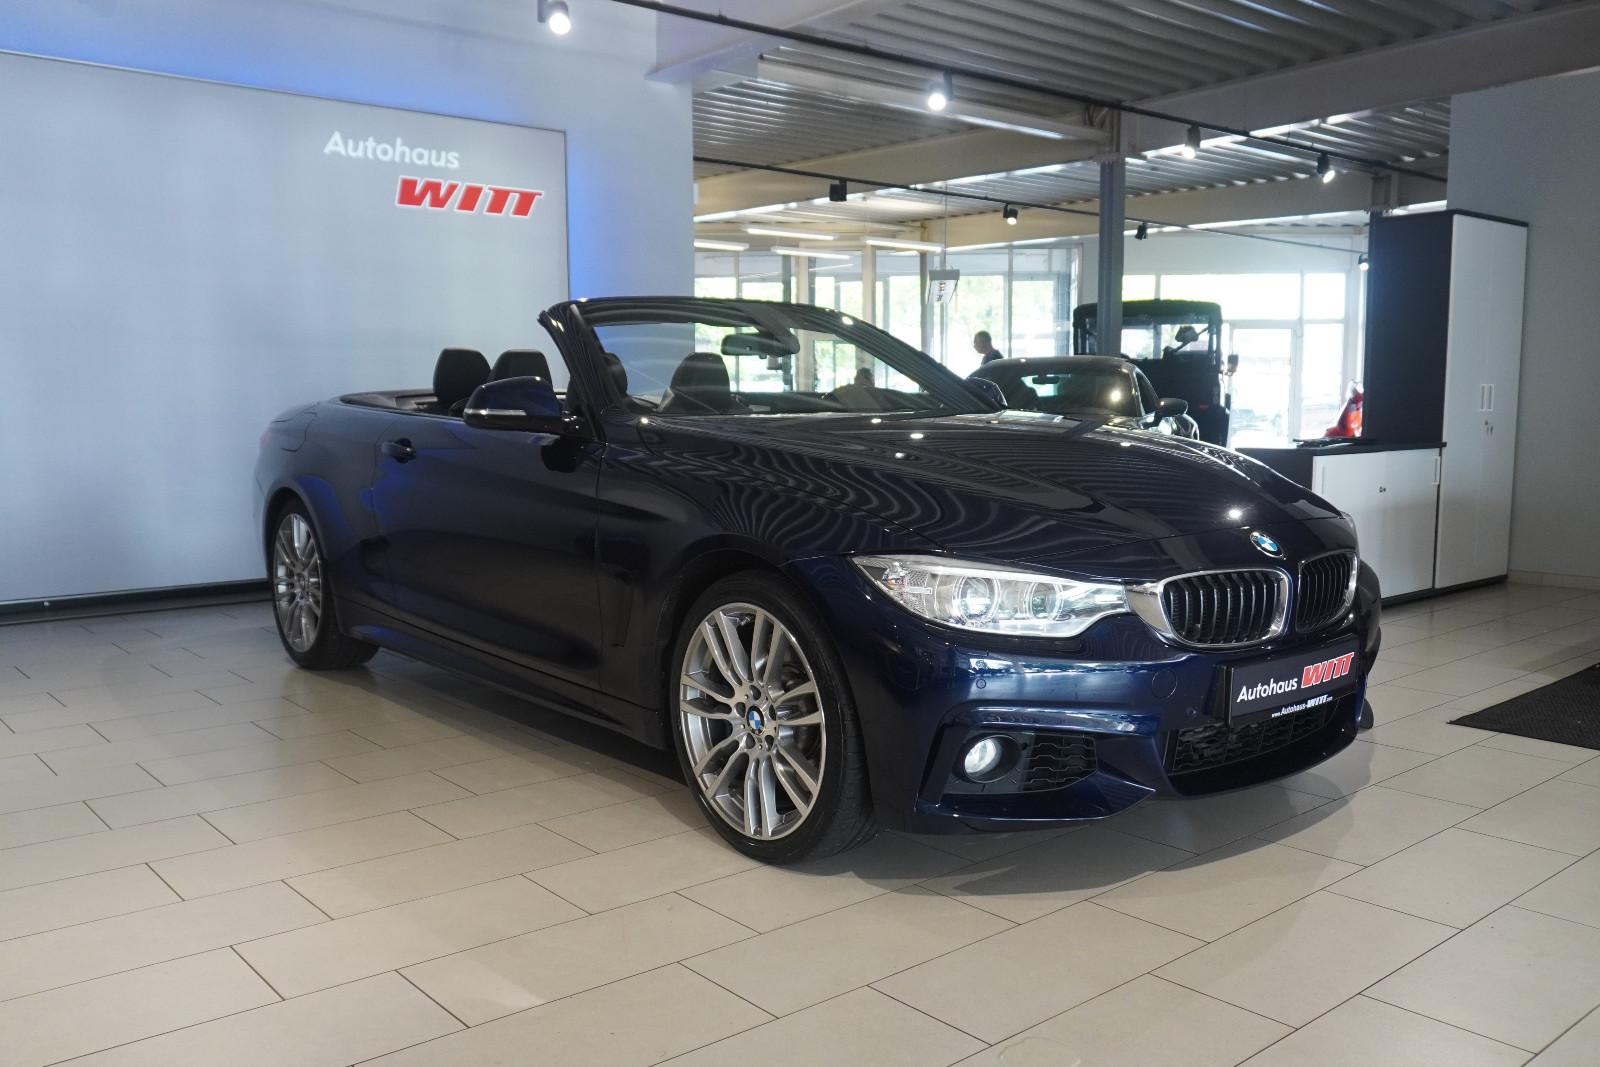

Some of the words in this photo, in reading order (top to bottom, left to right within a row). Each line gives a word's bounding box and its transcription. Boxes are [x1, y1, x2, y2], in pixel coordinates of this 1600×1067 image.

[323, 130, 460, 169] Autohaus
[396, 175, 544, 217] WITT
[1237, 678, 1298, 702] Autohaus
[1301, 652, 1354, 688] WITT
